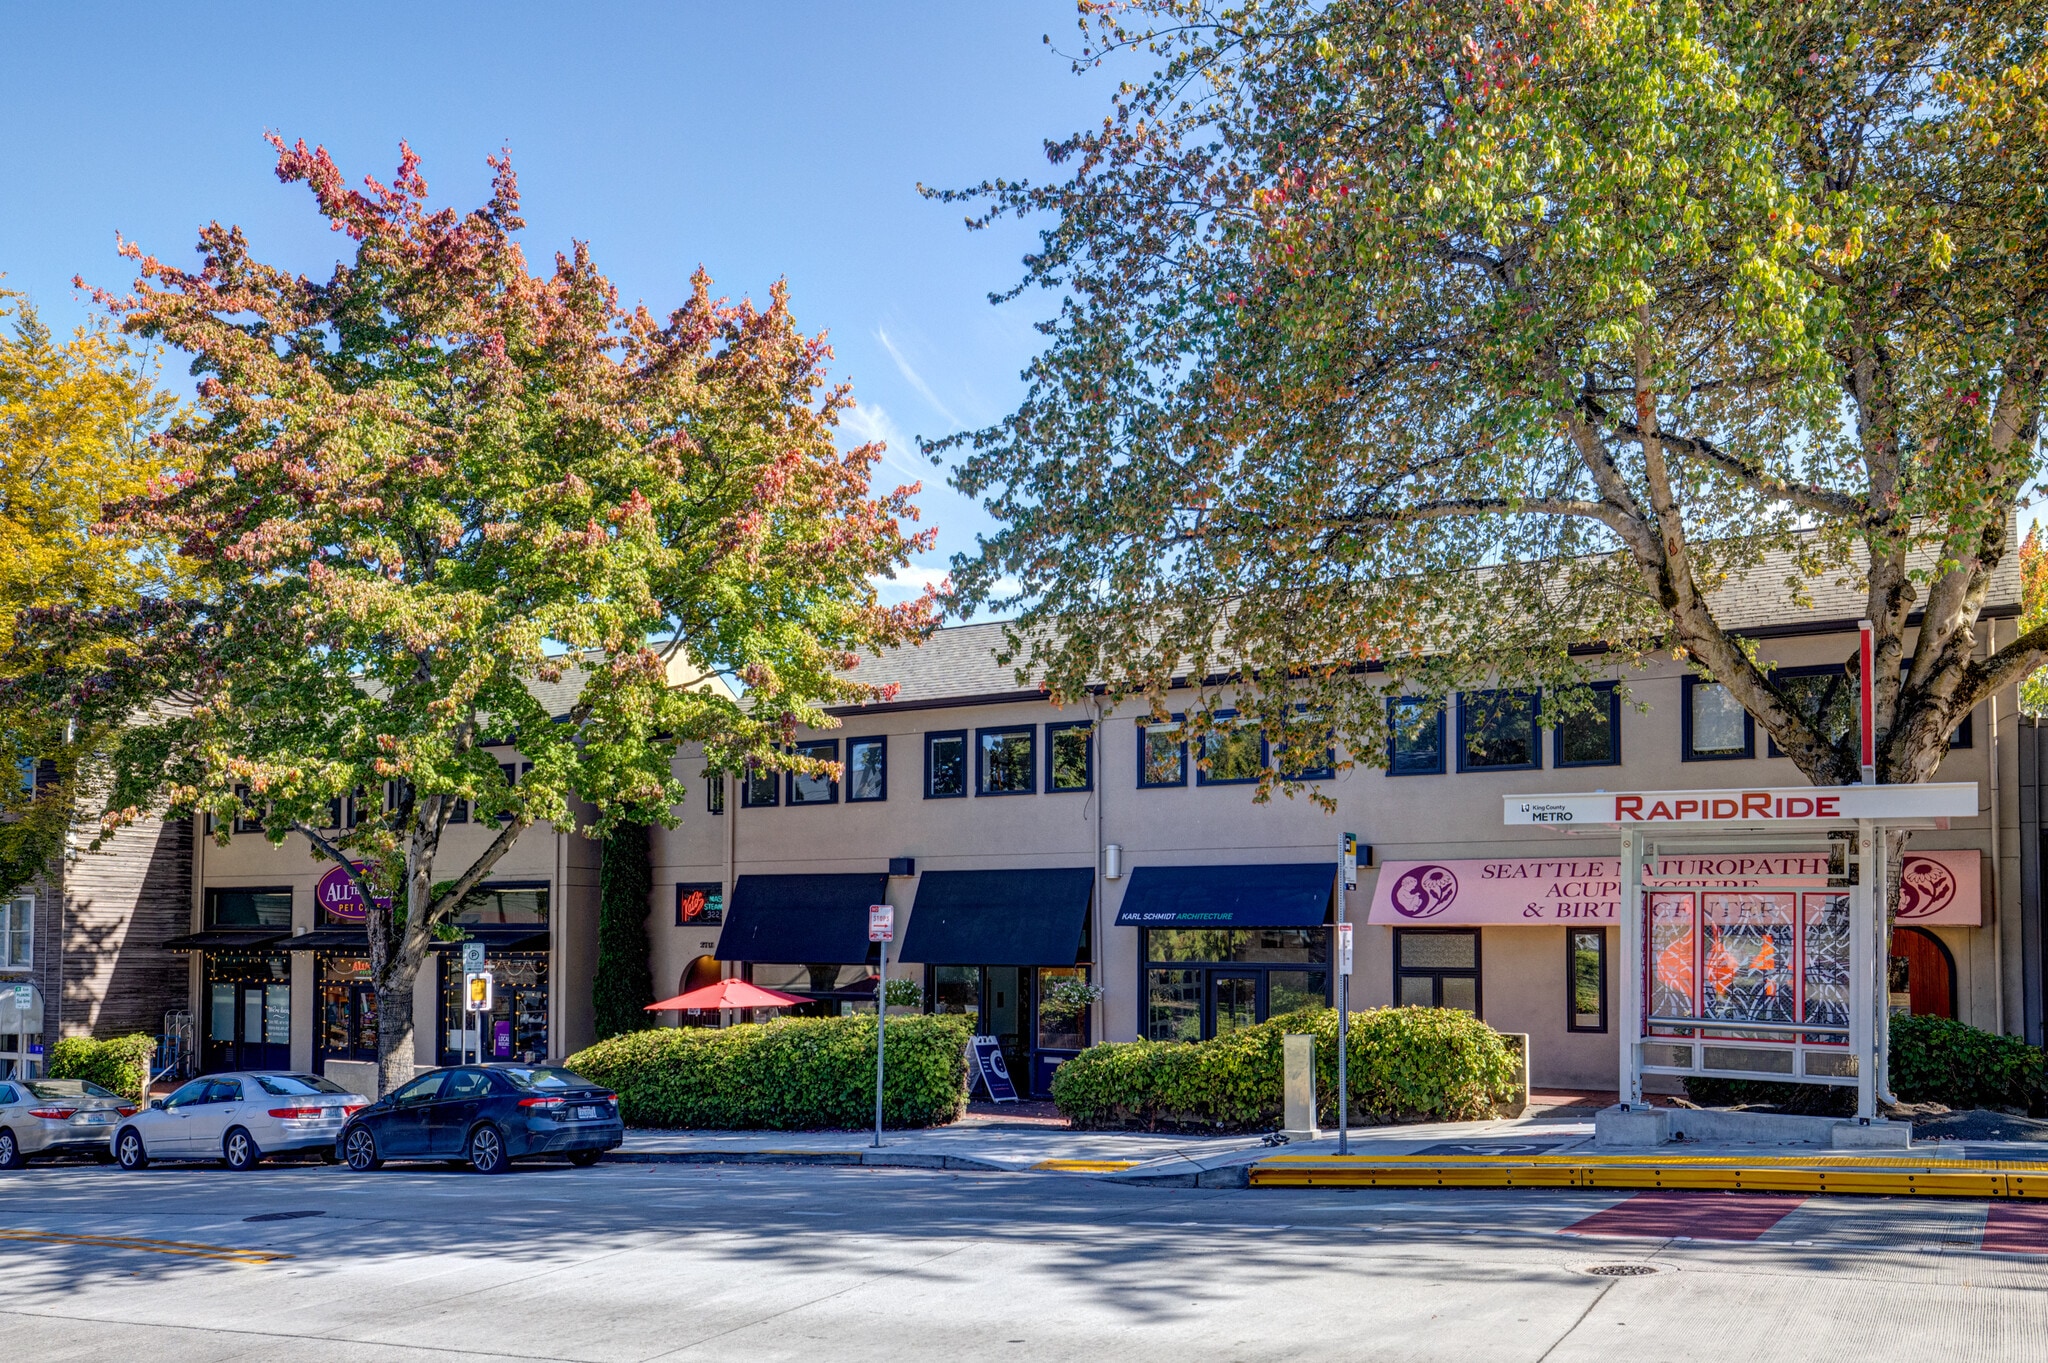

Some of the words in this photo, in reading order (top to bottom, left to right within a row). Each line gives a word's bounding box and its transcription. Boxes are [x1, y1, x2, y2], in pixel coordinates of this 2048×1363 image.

[1532, 812, 1573, 821] METRO
[1481, 862, 1604, 879] SEATTLE
[1615, 857, 1832, 877] ATUROPATH
[325, 882, 352, 902] ALL
[338, 903, 354, 912] PET
[1523, 902, 1545, 918] &
[1555, 902, 1622, 918] BIRT
[1121, 912, 1142, 920] KARL
[1142, 912, 1176, 920] SCHMIDT
[1176, 912, 1234, 920] ARCHITECTURE
